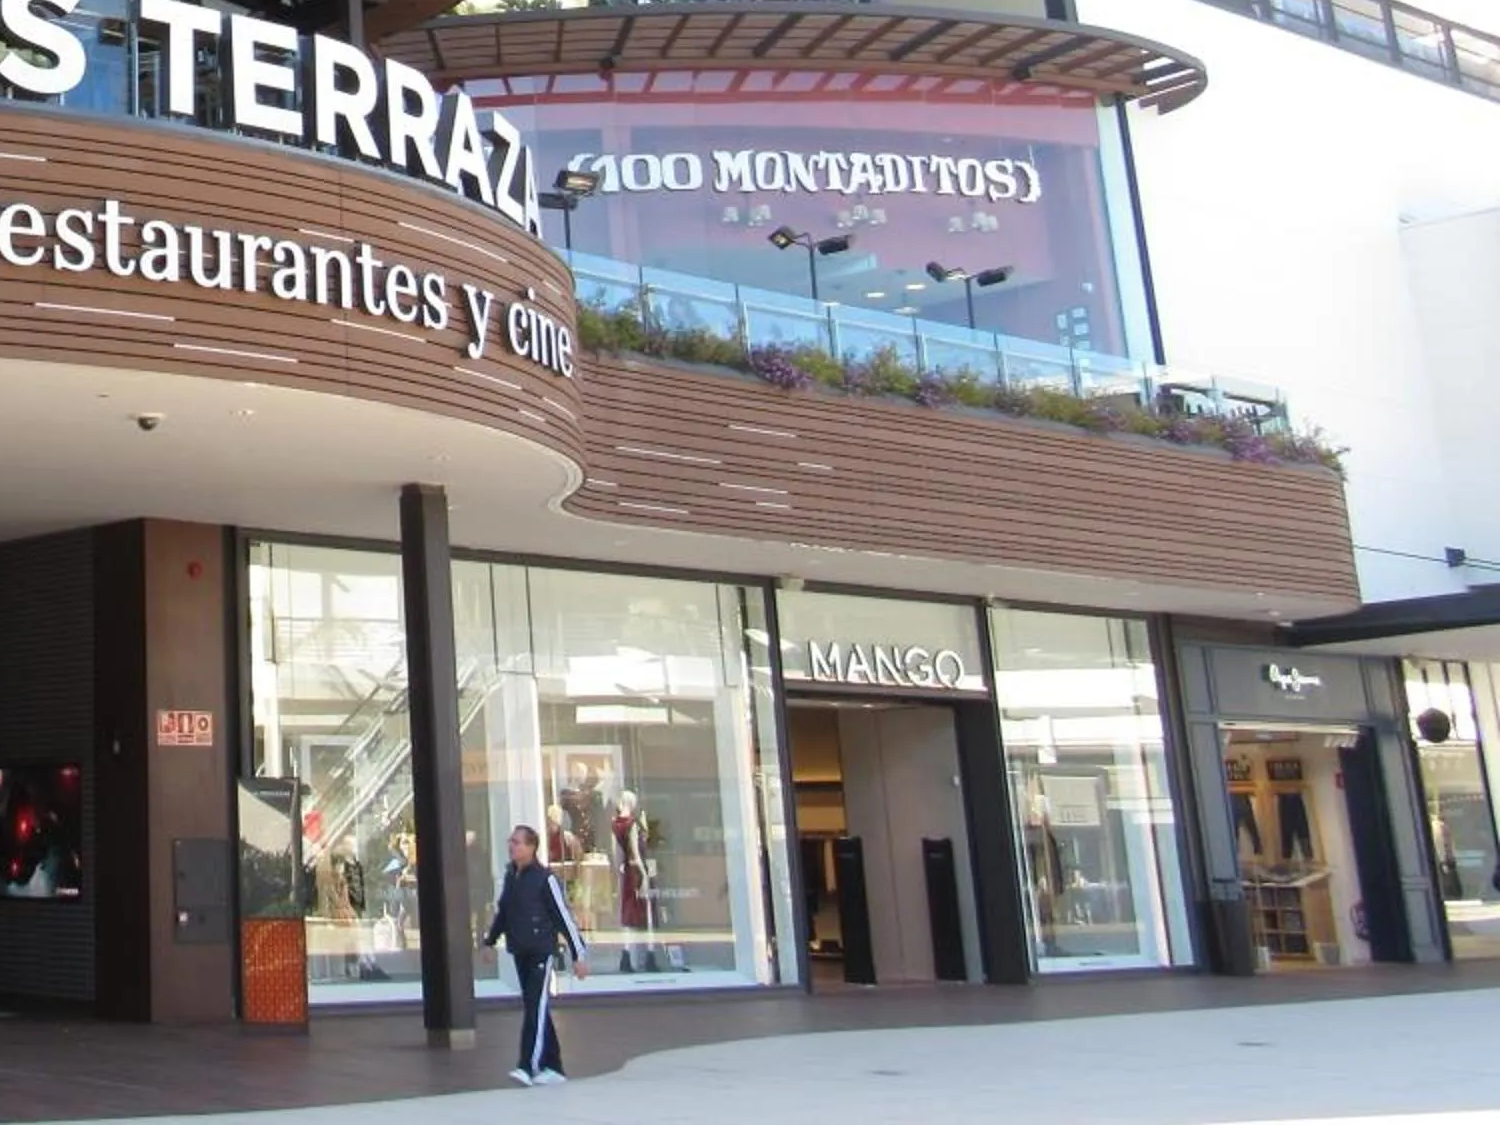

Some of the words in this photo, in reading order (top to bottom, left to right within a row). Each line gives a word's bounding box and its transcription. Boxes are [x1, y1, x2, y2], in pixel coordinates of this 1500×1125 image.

[462, 282, 494, 360] y
[507, 286, 574, 378] cine
[809, 639, 965, 690] MANGO
